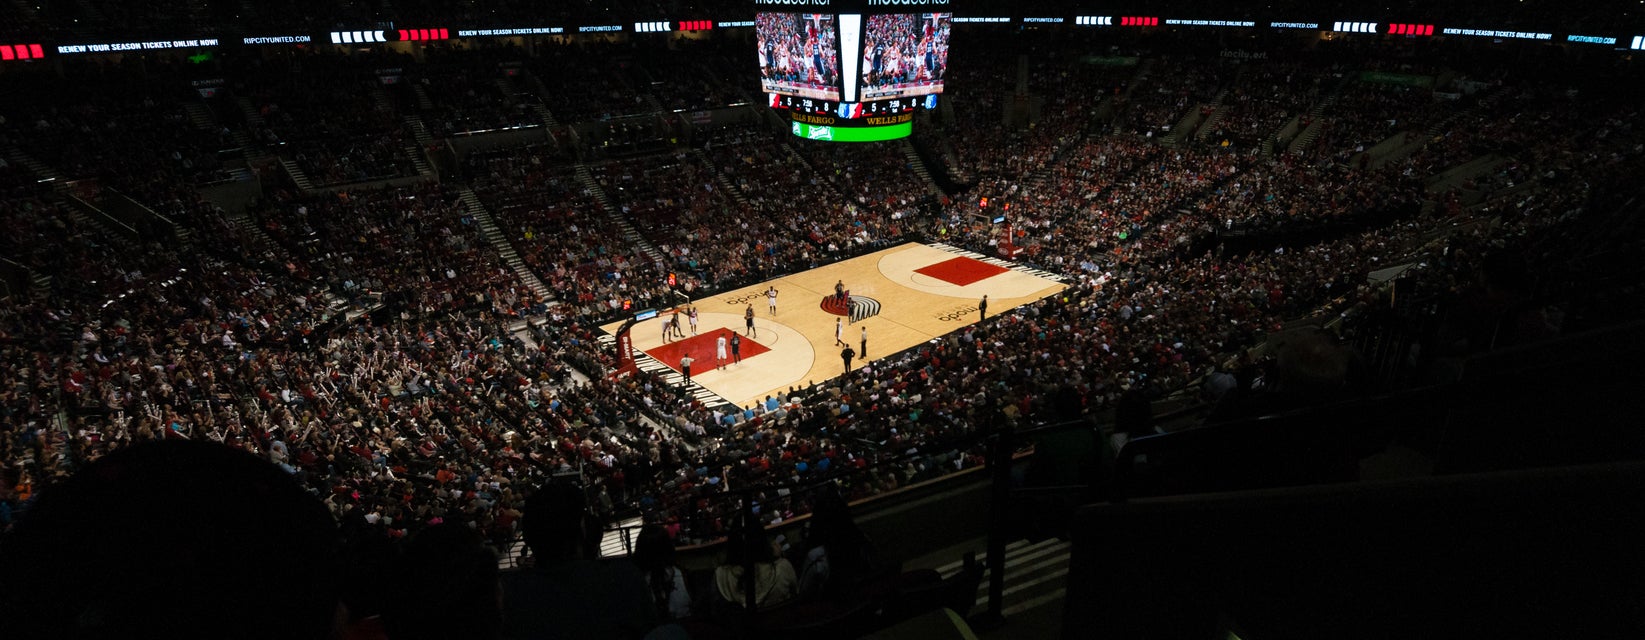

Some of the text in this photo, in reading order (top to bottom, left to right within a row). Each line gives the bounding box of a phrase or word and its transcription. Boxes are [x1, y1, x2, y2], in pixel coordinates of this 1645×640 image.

[1271, 21, 1319, 29] RIPCITYUNITED.COM
[493, 28, 513, 36] SEASON
[1443, 27, 1553, 40] RENEW YOUR SEASON TICKETS ONLINE NOW!
[243, 35, 311, 46] RIPCITYUNITED.COM
[1567, 34, 1618, 45] RIPCITYUNITED.COM
[58, 38, 219, 54] RENEW YOUR SEASON TICKETS ONLINE NOW!
[807, 115, 835, 125] FARGO
[866, 112, 913, 125] WELLS FAR
[938, 306, 978, 321] moda
